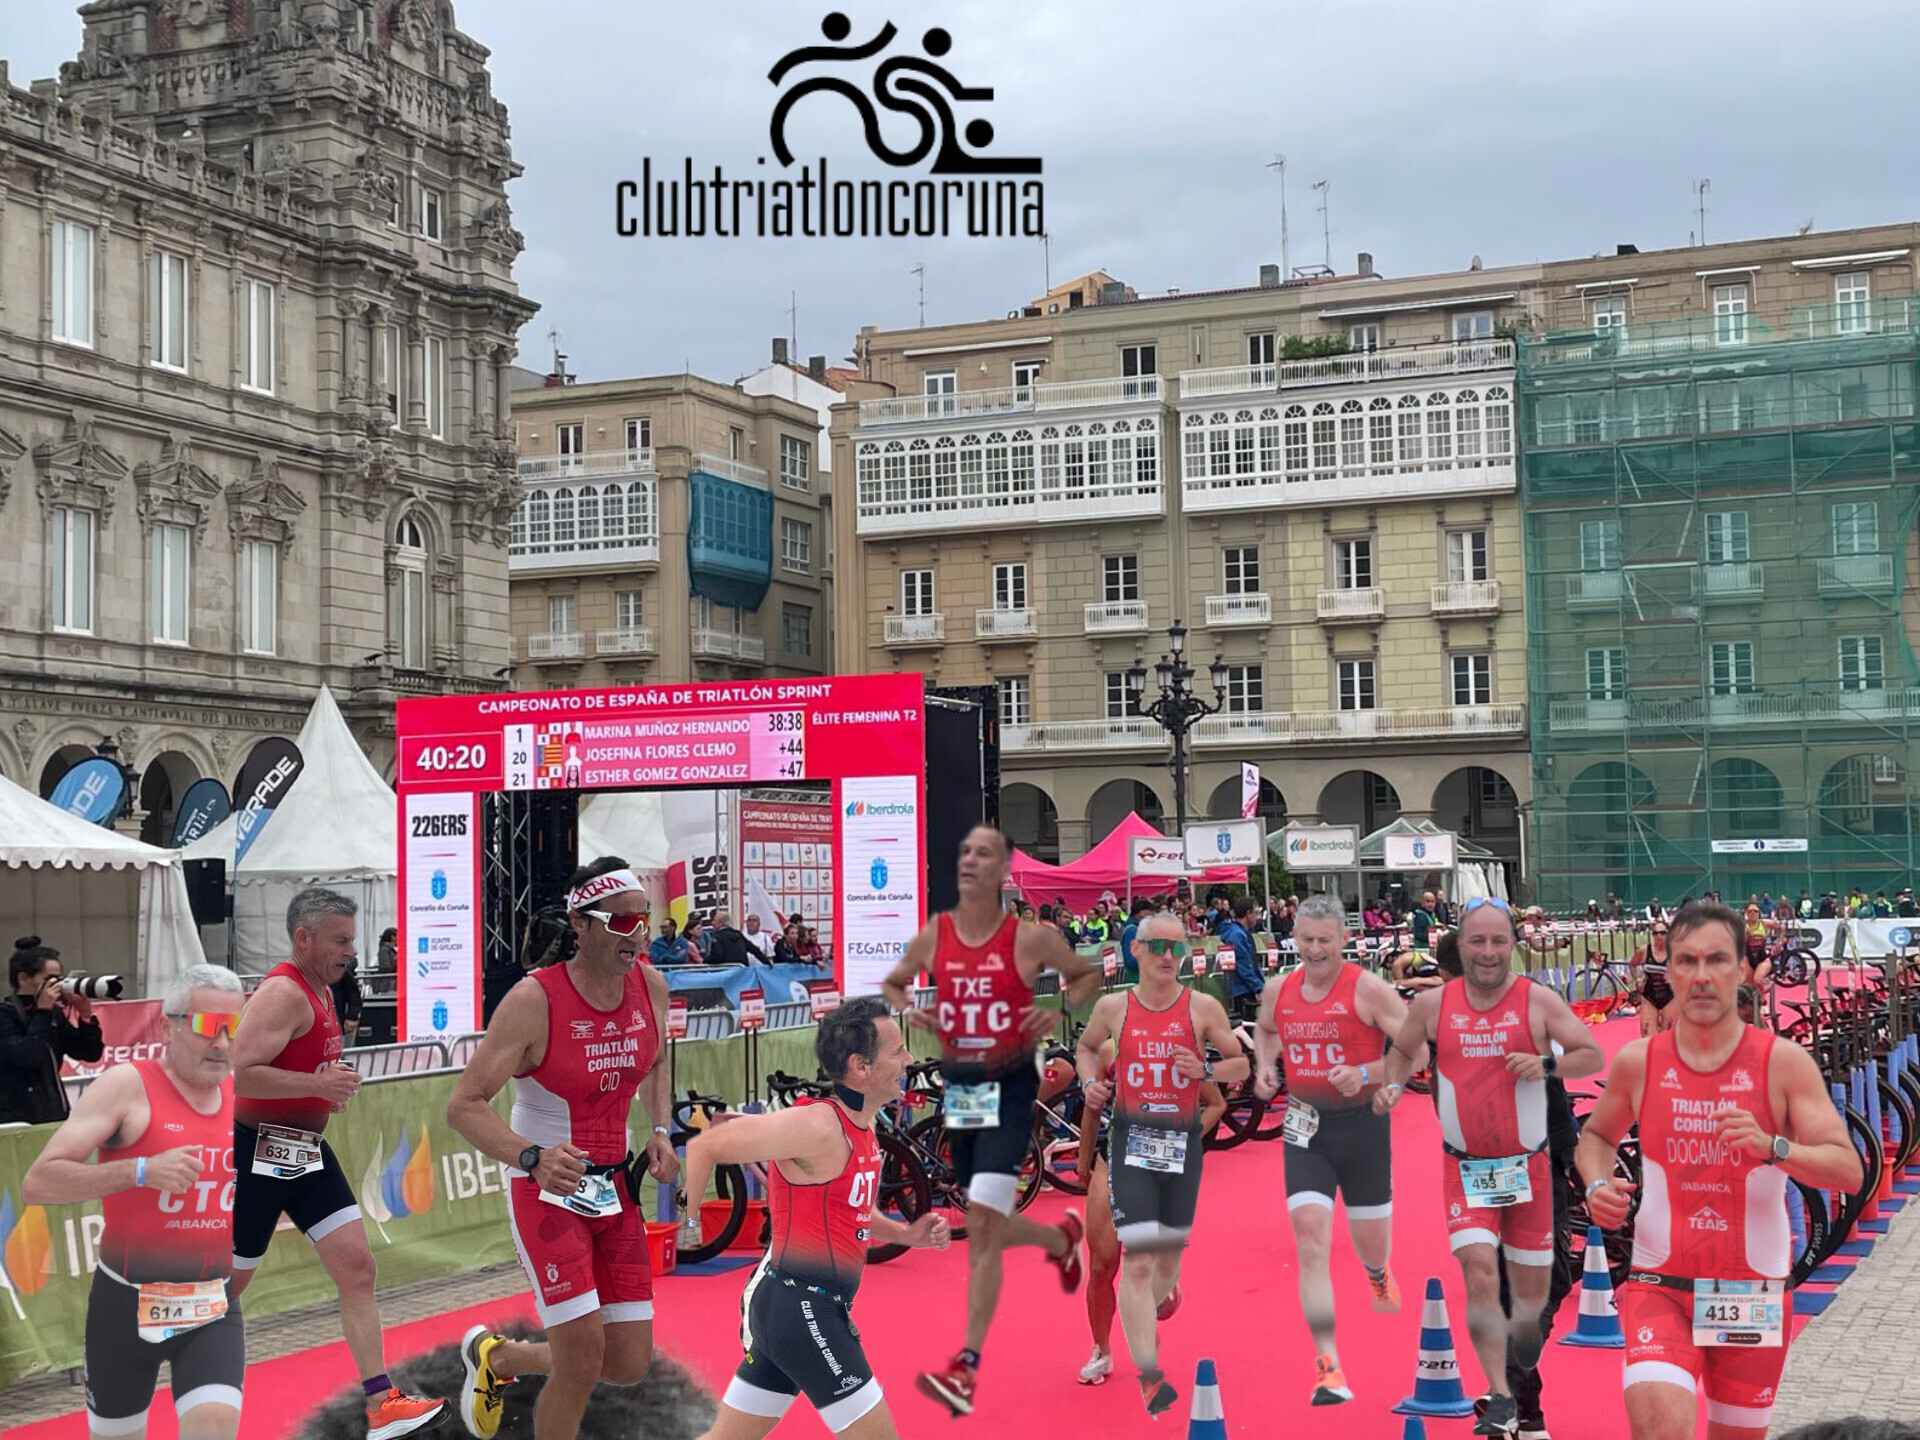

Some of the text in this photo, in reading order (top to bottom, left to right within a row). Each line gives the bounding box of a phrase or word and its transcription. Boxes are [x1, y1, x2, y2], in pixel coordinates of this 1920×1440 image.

[478, 684, 832, 714] CAMPEONATO DE ESPAÑA DE TRIATLÓN SPRINT
[768, 713, 803, 732] 38:38
[843, 711, 900, 724] FEMENINA
[904, 709, 917, 721] T2
[516, 728, 523, 743] 1
[584, 719, 750, 739] MARINA MUÑOZ HERNANDO
[584, 742, 736, 762] JOSEFINA FLORES CLEMO
[779, 738, 804, 756] +44
[416, 744, 487, 771] 40:20
[512, 751, 527, 765] 20
[585, 764, 748, 783] ESTHER GOMEZ GONZALEZ
[779, 761, 804, 778] +47
[512, 773, 527, 786] 21
[412, 815, 468, 838] 226ERS
[847, 893, 913, 901] Concello da Coruña
[951, 977, 993, 998] TXE
[938, 1000, 1012, 1035] CTC
[1459, 1030, 1507, 1044] TRIATLÓN
[584, 1036, 639, 1058] TRIATLÓN
[1138, 1041, 1174, 1058] LEMA
[1288, 1043, 1346, 1065] CTC
[1462, 1043, 1505, 1058] CORUÑA
[587, 1053, 636, 1073] CORUÑA
[600, 1071, 620, 1092] CID
[1127, 1062, 1190, 1089] CTC
[1673, 1116, 1731, 1134] CORU
[266, 1145, 290, 1161] 632
[1472, 1178, 1497, 1190] 453
[1688, 1216, 1729, 1232] TEAIS
[800, 1300, 815, 1320] CLUB
[1704, 1305, 1740, 1321] 413
